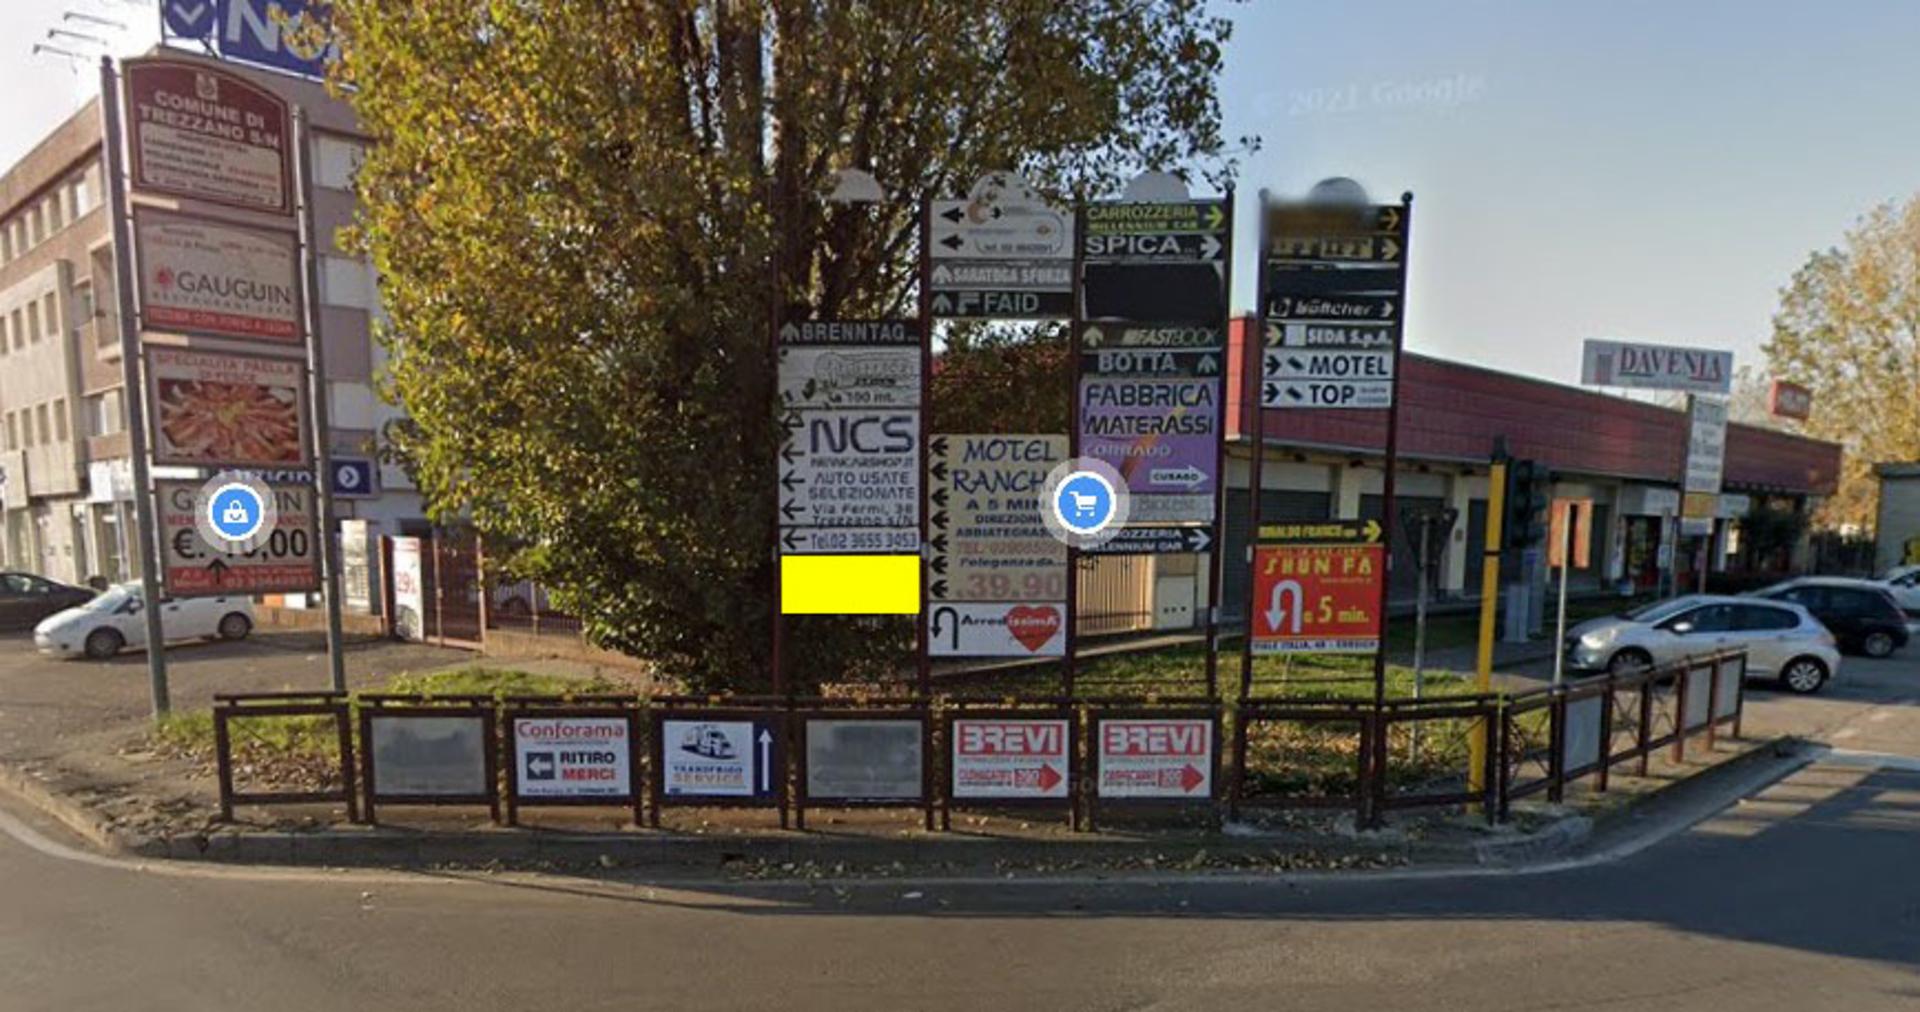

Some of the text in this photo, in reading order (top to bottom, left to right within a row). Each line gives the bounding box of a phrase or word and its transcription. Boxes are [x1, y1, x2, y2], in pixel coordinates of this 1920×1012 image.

[154, 90, 265, 128] COMUNE DI
[138, 103, 245, 139] TREZZANO
[1086, 205, 1199, 220] CARROZZERIA
[1173, 220, 1198, 230] CAR
[1085, 236, 1181, 254] SPICA
[177, 270, 292, 305] GAUGUIN
[984, 293, 1040, 312] FAID
[802, 322, 905, 341] BRENNTAG
[1307, 328, 1346, 345] SEDA
[1098, 353, 1177, 372] BOTTA
[1308, 355, 1390, 377] MOTEL
[1620, 347, 1724, 380] DAVENIA
[1085, 384, 1213, 406] FABBRICA
[1308, 384, 1357, 405] TOP
[1084, 415, 1213, 435] MATERASSI
[810, 416, 914, 454] NCS
[963, 439, 1059, 463] MOTEL
[814, 471, 910, 485] AUTO USATE
[951, 469, 1056, 494] RANCH
[808, 487, 915, 500] SELEZIONATE
[812, 503, 836, 514] Via
[1263, 556, 1331, 575] SHUN
[1317, 595, 1333, 623] 5
[1337, 606, 1370, 623] min.
[518, 721, 625, 739] Conforama
[962, 725, 1058, 753] BREVI
[1108, 725, 1202, 753] BREVI
[560, 751, 616, 764] RITIRO
[562, 768, 616, 780] MERCI
